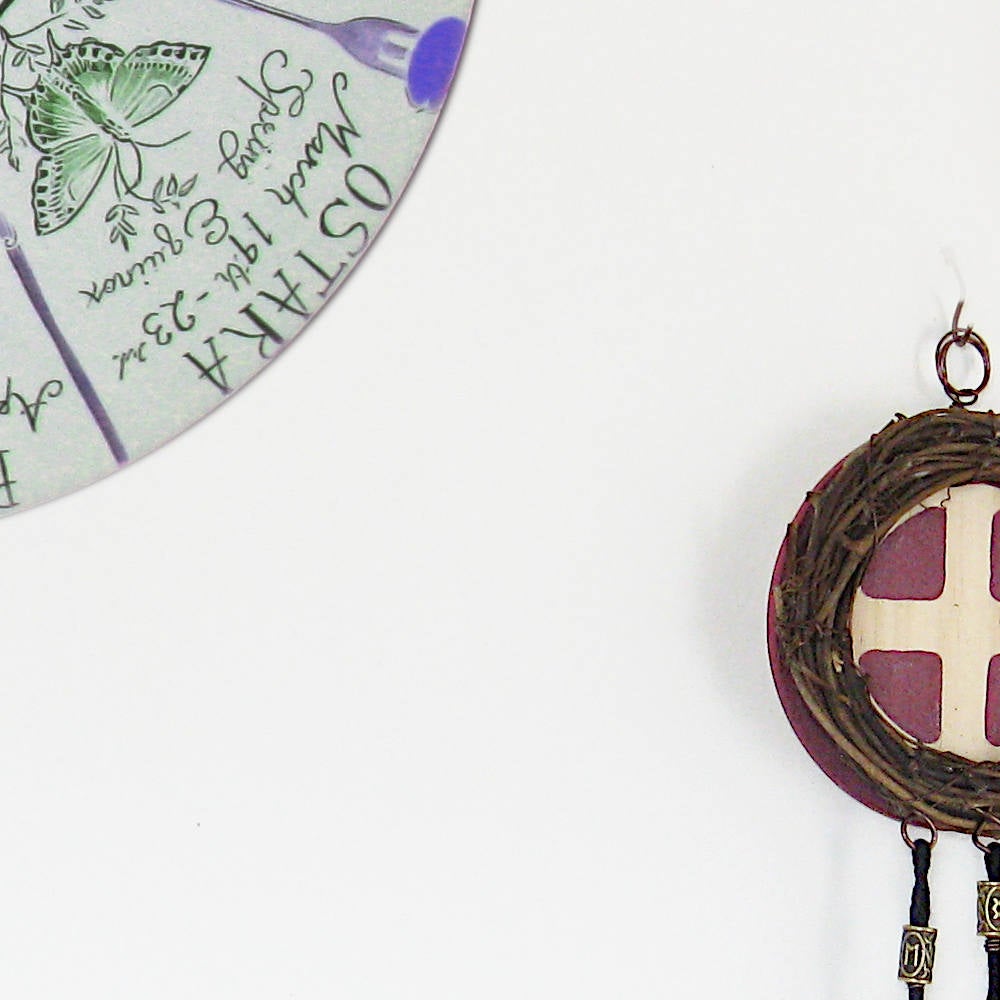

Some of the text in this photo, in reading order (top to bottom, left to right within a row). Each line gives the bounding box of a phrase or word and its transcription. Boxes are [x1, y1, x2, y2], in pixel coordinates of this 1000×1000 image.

[79, 49, 314, 305] Spring Equinox
[265, 71, 361, 219] March
[183, 163, 392, 394] OSTARA
